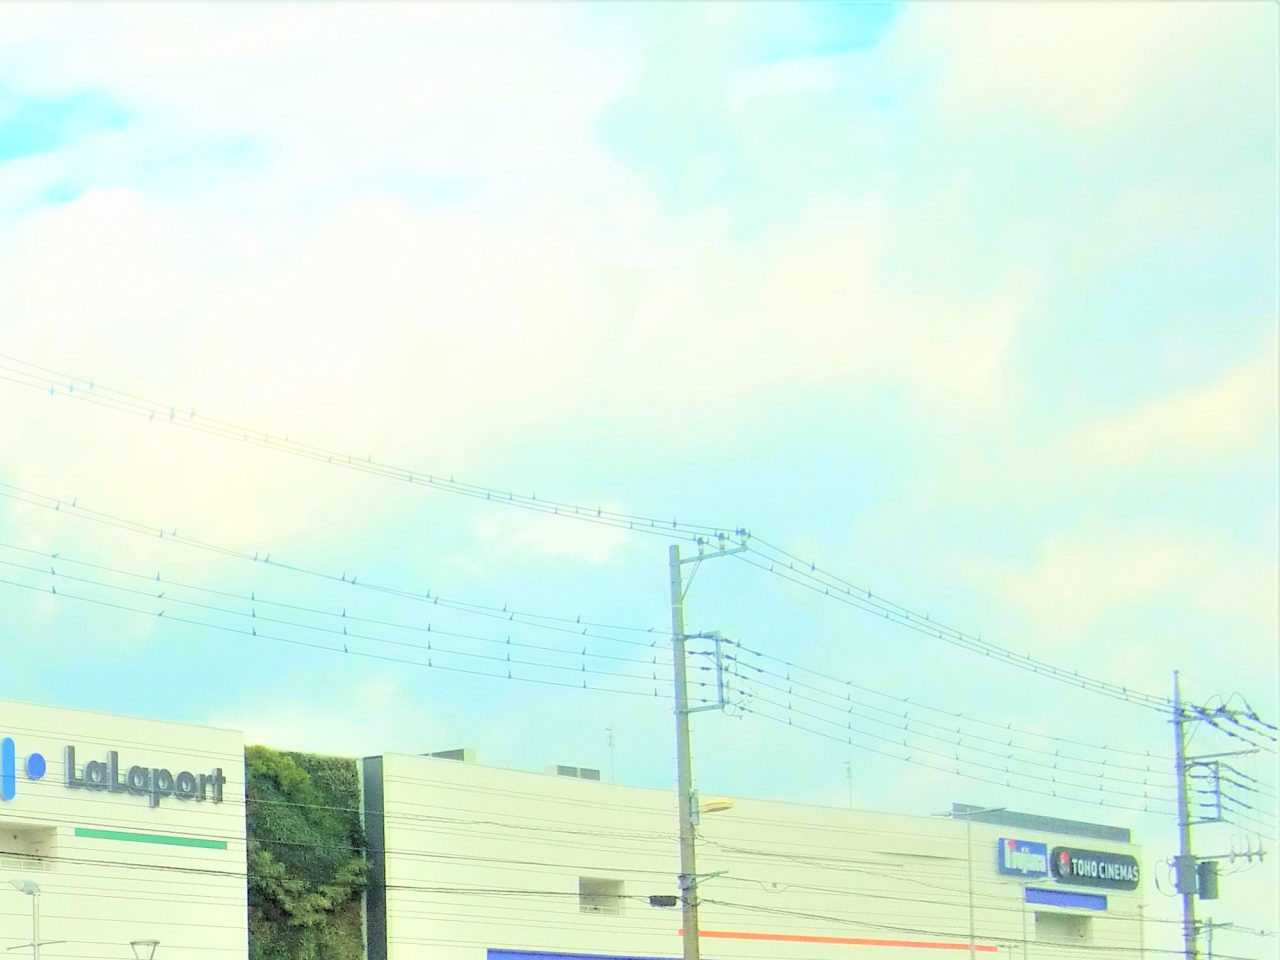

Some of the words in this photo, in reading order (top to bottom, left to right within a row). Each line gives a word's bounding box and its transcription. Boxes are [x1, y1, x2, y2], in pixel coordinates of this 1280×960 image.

[64, 746, 227, 808] LaLaport
[1072, 859, 1097, 877] TOHO
[1099, 862, 1138, 882] CINEMAS
